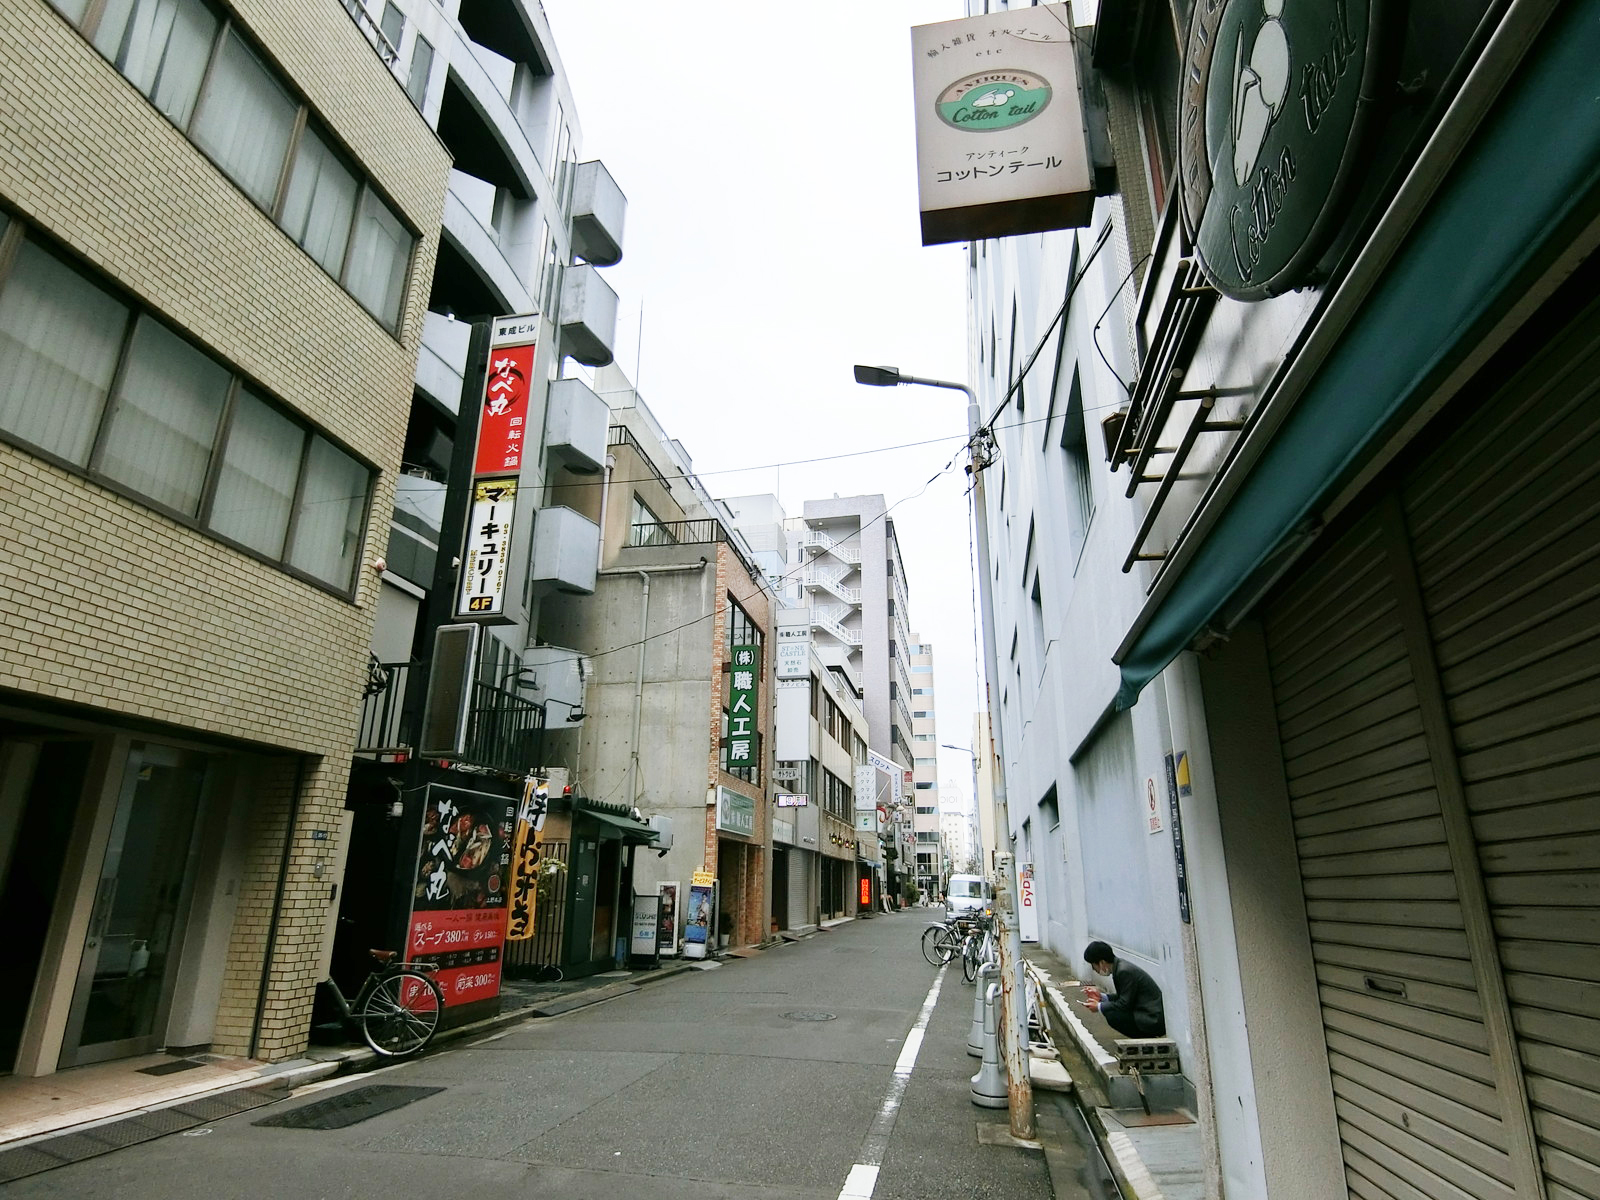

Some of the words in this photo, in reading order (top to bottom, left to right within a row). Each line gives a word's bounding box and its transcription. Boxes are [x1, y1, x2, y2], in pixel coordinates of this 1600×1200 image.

[927, 33, 976, 59] 輸入雑貨
[988, 28, 1052, 41] オルゴール
[975, 49, 1003, 58] etc
[955, 74, 1030, 97] ANTIQUES
[952, 107, 999, 123] Cotton
[1007, 101, 1036, 116] tail
[966, 146, 1029, 161] アンティーク
[937, 155, 1063, 184] コットンテール
[1230, 145, 1296, 283] Cotton
[497, 323, 536, 337] 東成ビル
[488, 357, 518, 417] なべ丸
[504, 416, 523, 467] 回転火鍋
[478, 487, 507, 594] マーキュリー
[470, 597, 493, 611] 4F
[785, 630, 807, 638] 職人工房
[869, 756, 890, 770] スロット
[427, 799, 459, 901] なべ丸
[415, 930, 444, 945] スープ
[445, 930, 460, 943] 380
[457, 976, 474, 990] 前菜
[474, 974, 488, 987] 300
